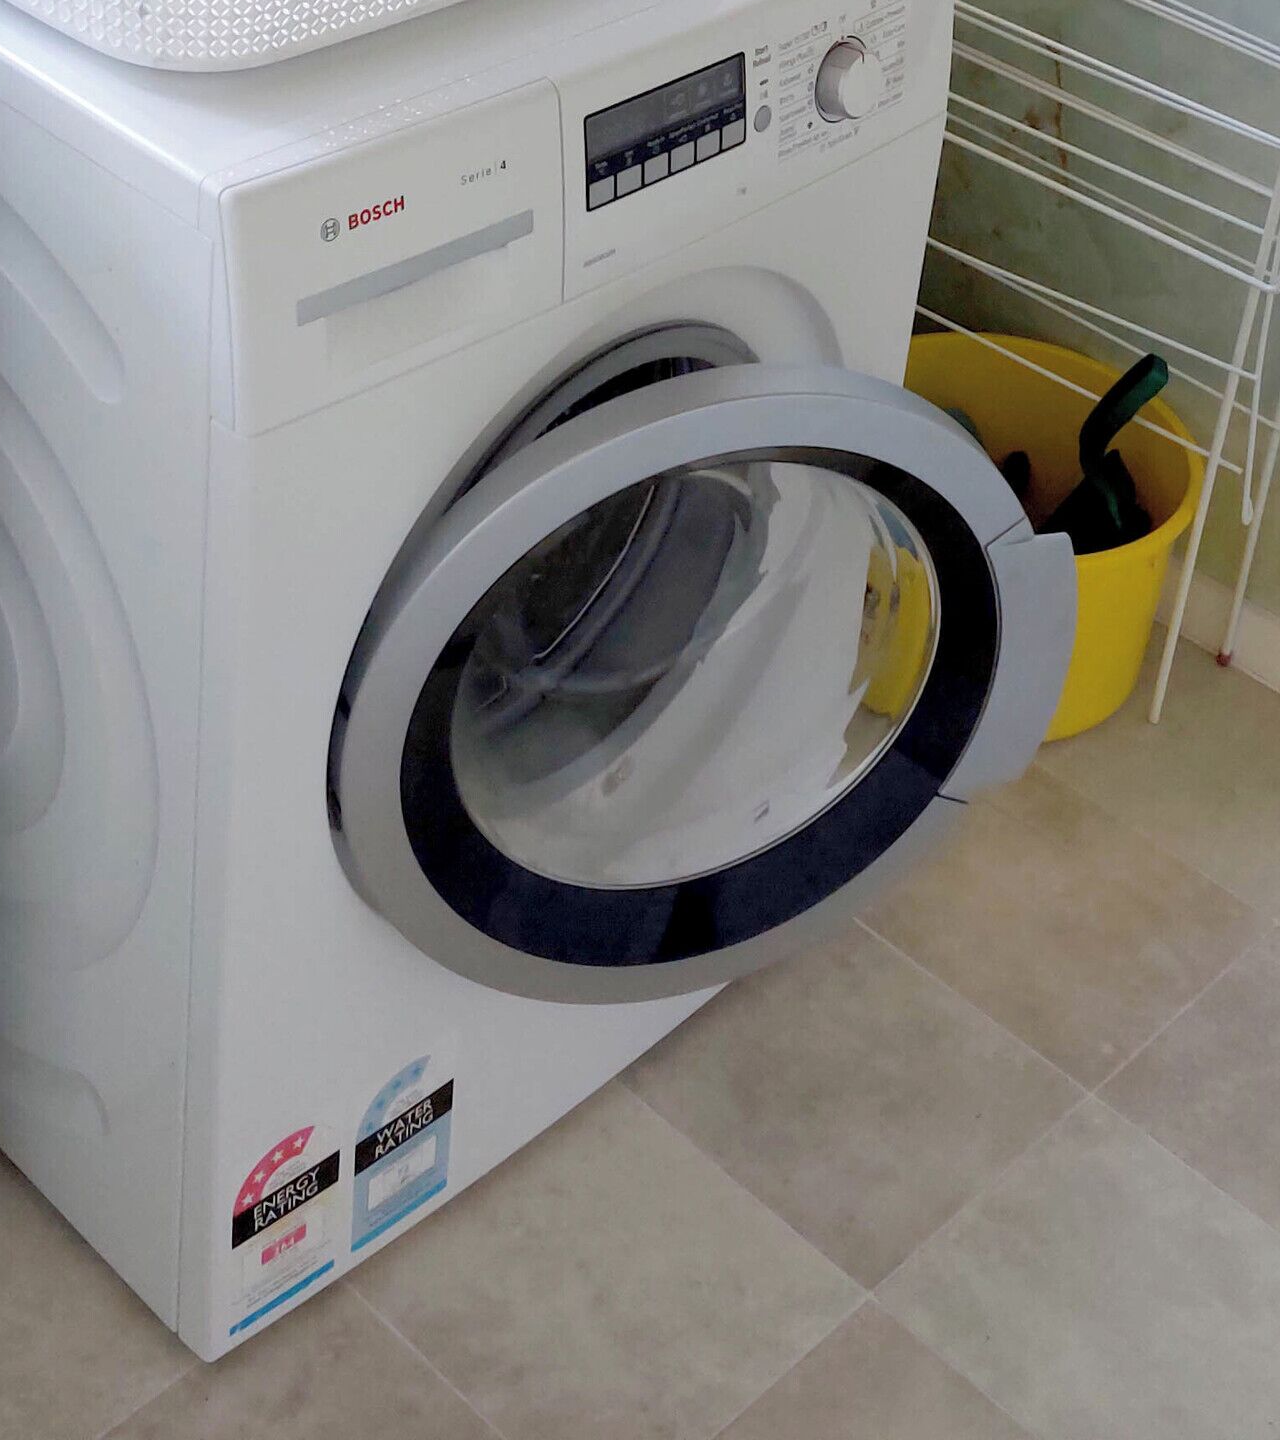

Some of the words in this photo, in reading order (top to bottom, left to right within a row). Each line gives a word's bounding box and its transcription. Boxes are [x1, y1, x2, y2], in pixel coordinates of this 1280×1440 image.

[460, 166, 492, 186] Serie
[500, 160, 507, 170] 4
[348, 195, 405, 231] BOSCH
[374, 1111, 434, 1160] RATING
[376, 1098, 433, 1143] WATER
[253, 1166, 320, 1220] ENERGY
[254, 1183, 319, 1232] RATING
